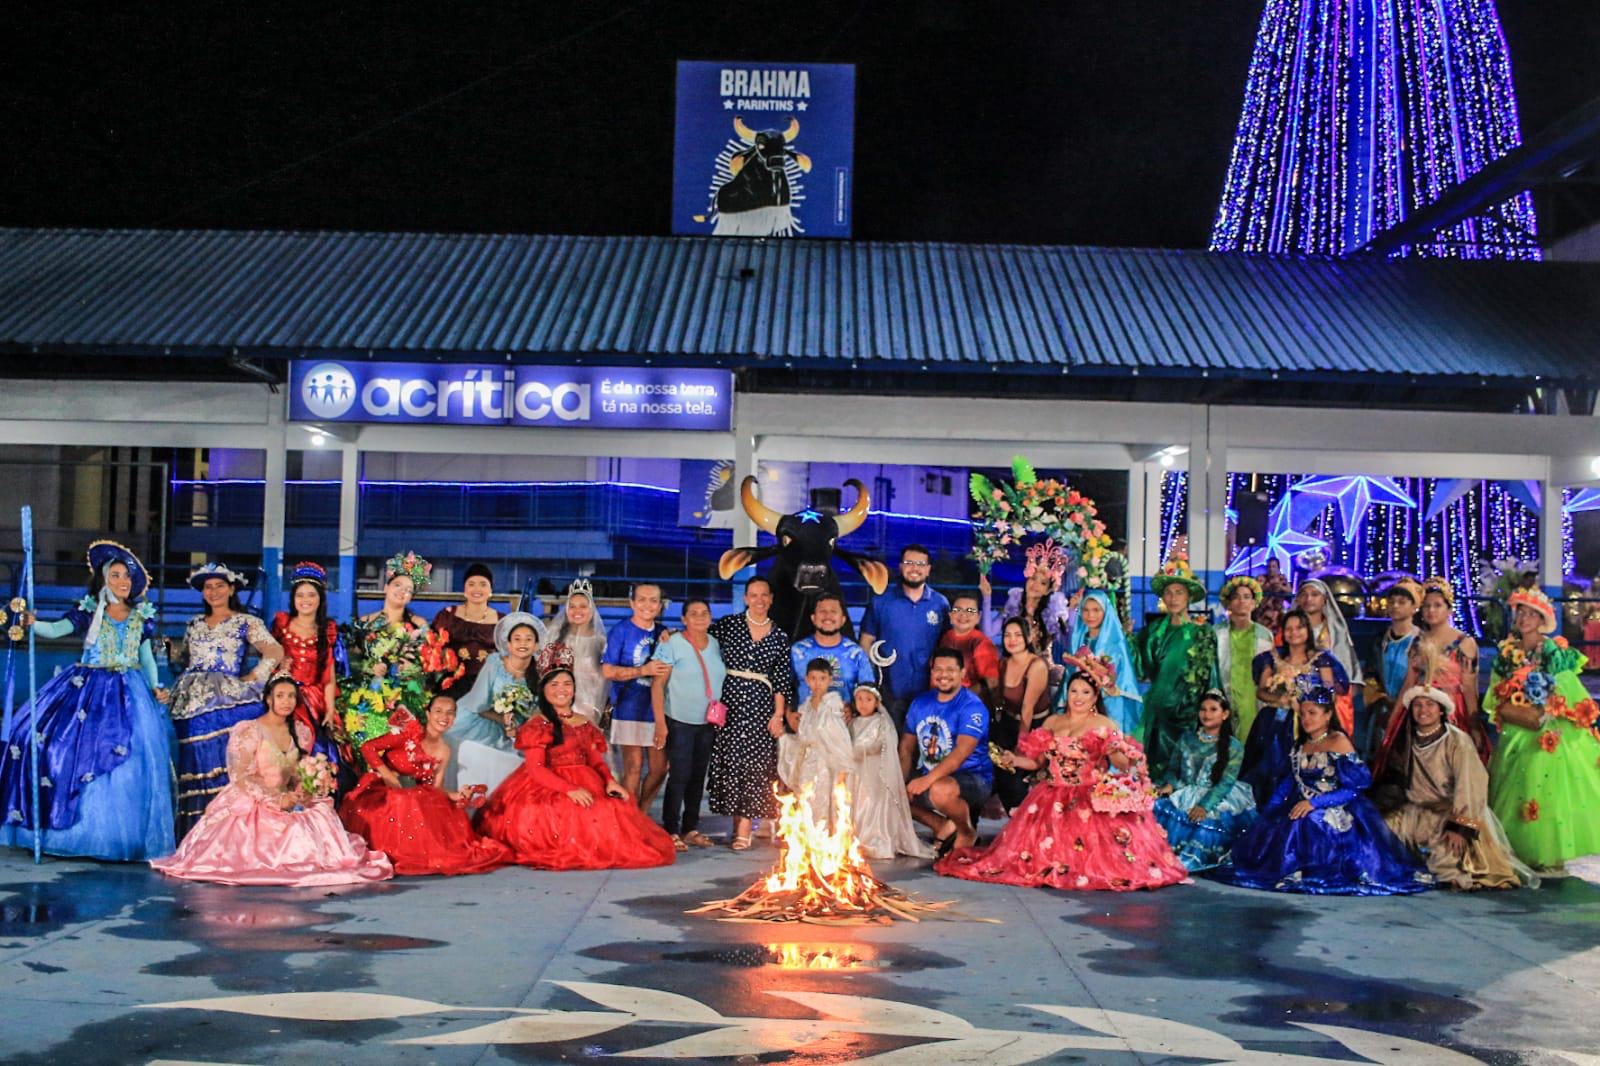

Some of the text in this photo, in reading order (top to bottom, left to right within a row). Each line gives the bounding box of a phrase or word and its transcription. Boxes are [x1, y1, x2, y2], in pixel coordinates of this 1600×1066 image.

[720, 69, 811, 98] BRAHMA
[737, 99, 794, 111] PARINTINS
[361, 369, 591, 421] acrítica
[601, 378, 718, 398] É da nossa terra,
[602, 399, 717, 416] tá na nossa tela.
